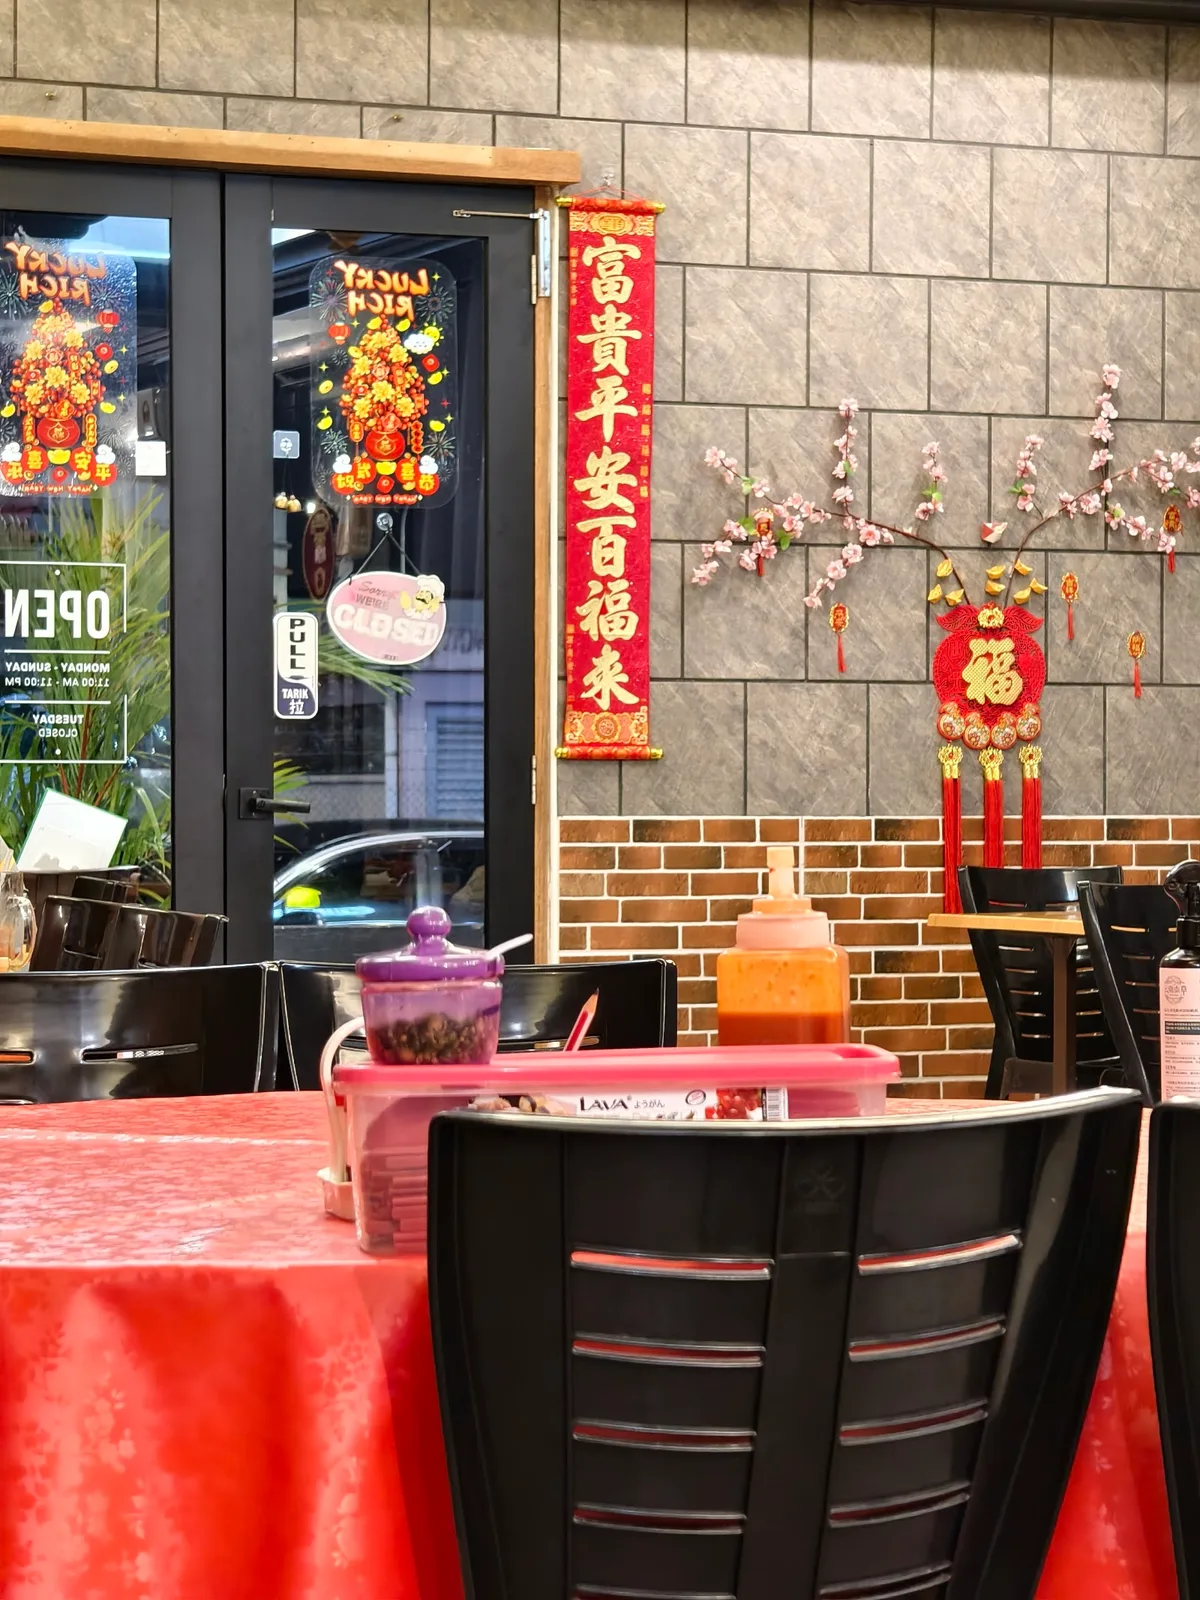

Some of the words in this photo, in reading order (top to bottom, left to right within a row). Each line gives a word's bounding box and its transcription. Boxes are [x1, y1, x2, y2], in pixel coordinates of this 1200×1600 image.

[333, 604, 439, 646] CLOSED
[290, 618, 305, 670] PULL
[962, 638, 1023, 706] 福
[282, 688, 309, 699] TARIK
[289, 700, 304, 715] 拉
[580, 1096, 628, 1111] LAVA
